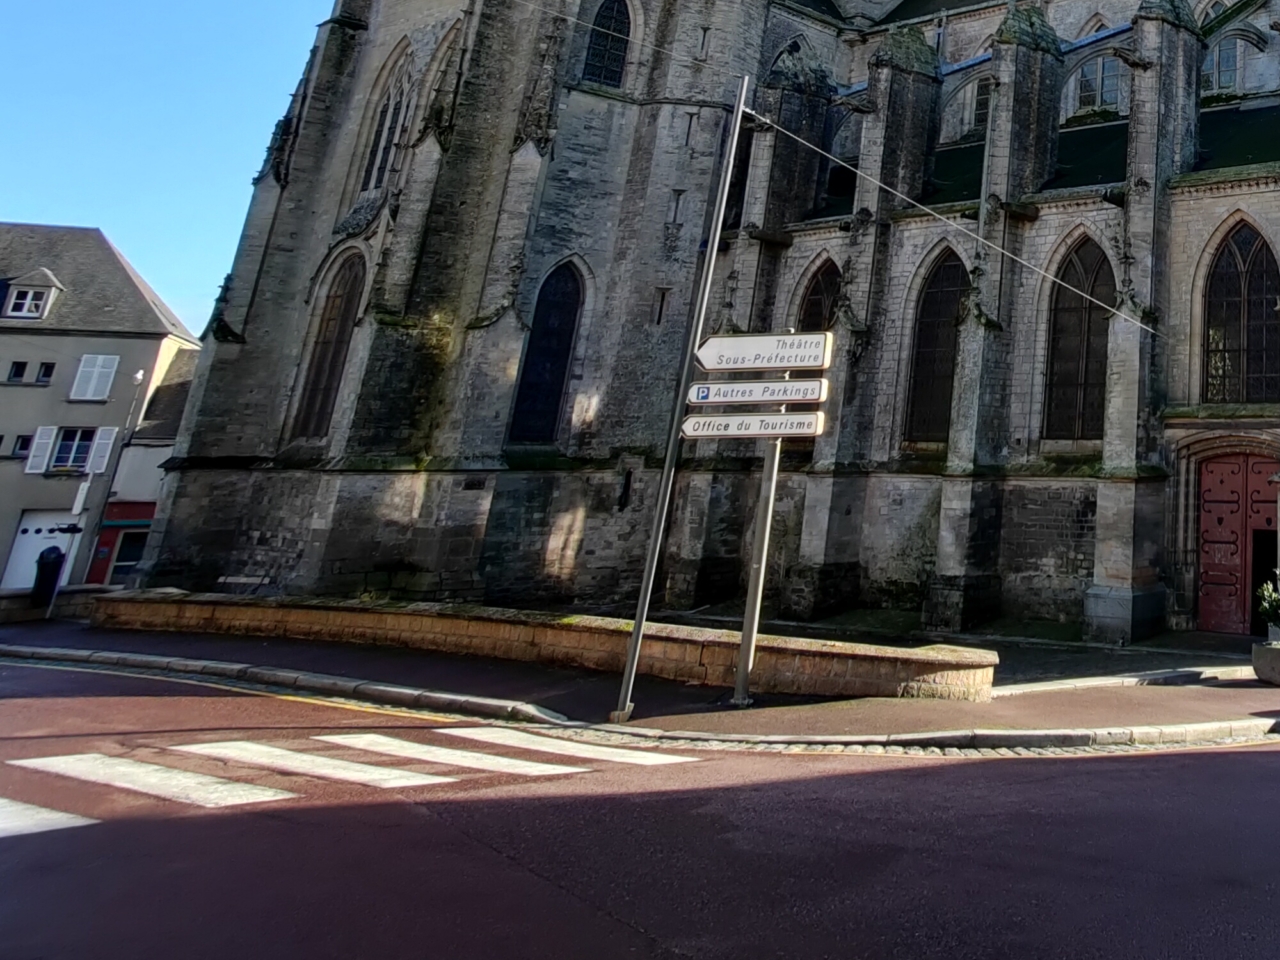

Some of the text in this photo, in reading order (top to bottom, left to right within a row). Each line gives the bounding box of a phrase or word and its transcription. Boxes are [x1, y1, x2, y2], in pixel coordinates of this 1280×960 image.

[775, 339, 821, 350] Théâtre
[716, 353, 820, 366] Sous-Préfecture
[713, 387, 754, 398] Autres
[761, 385, 816, 398] Parkings
[692, 419, 813, 432] Office du Tourisme
